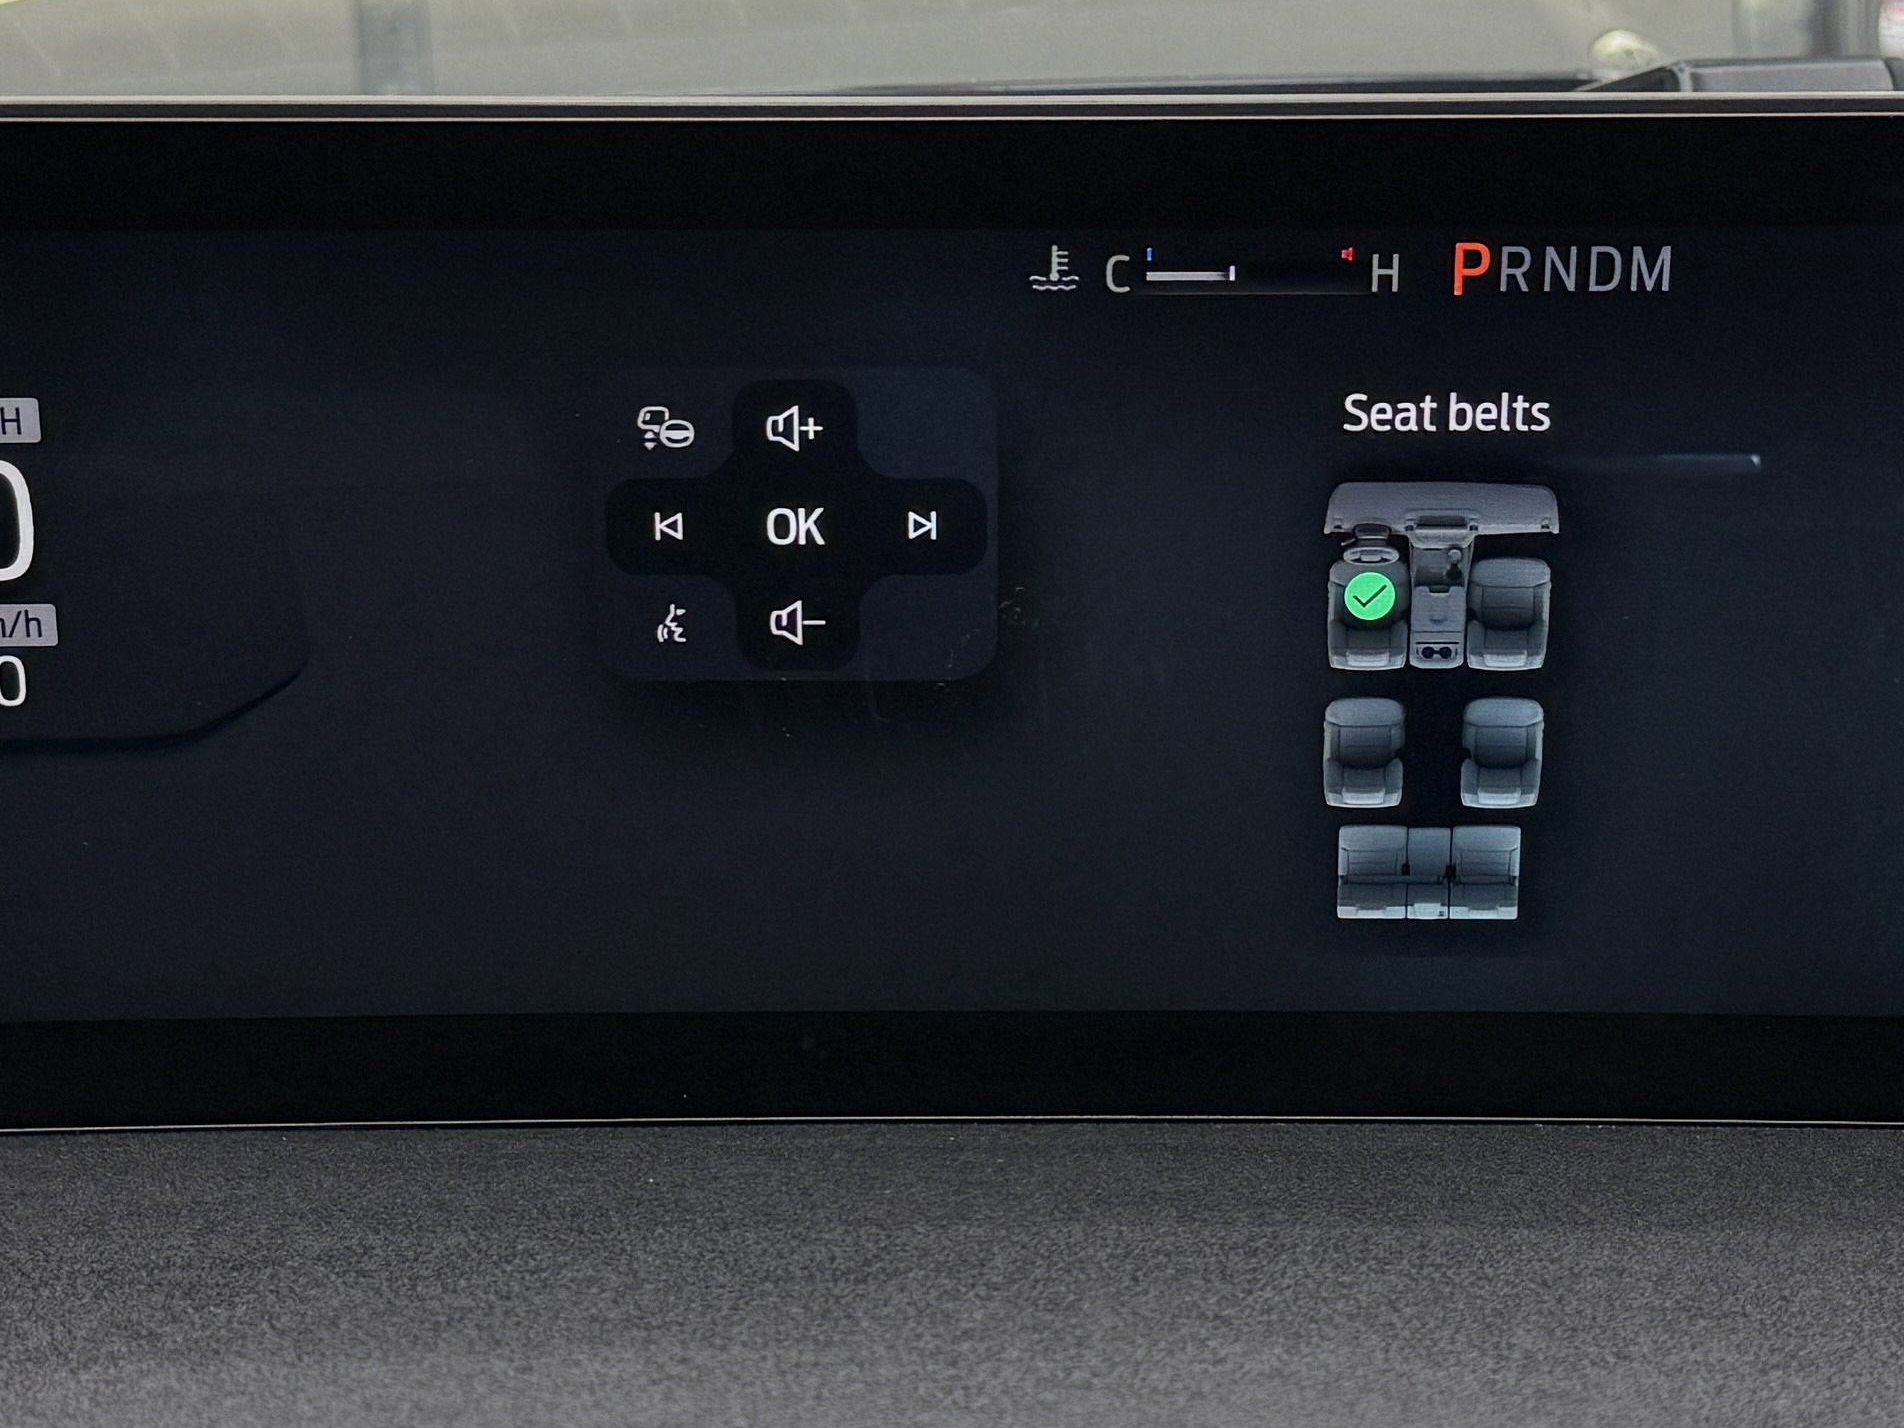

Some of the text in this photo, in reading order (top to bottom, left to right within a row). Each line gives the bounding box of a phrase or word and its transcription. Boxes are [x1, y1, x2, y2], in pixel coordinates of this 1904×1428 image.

[1105, 255, 1131, 293] C
[1371, 254, 1399, 293] H
[1342, 392, 1551, 432] Seat belts
[766, 507, 826, 546] OK
